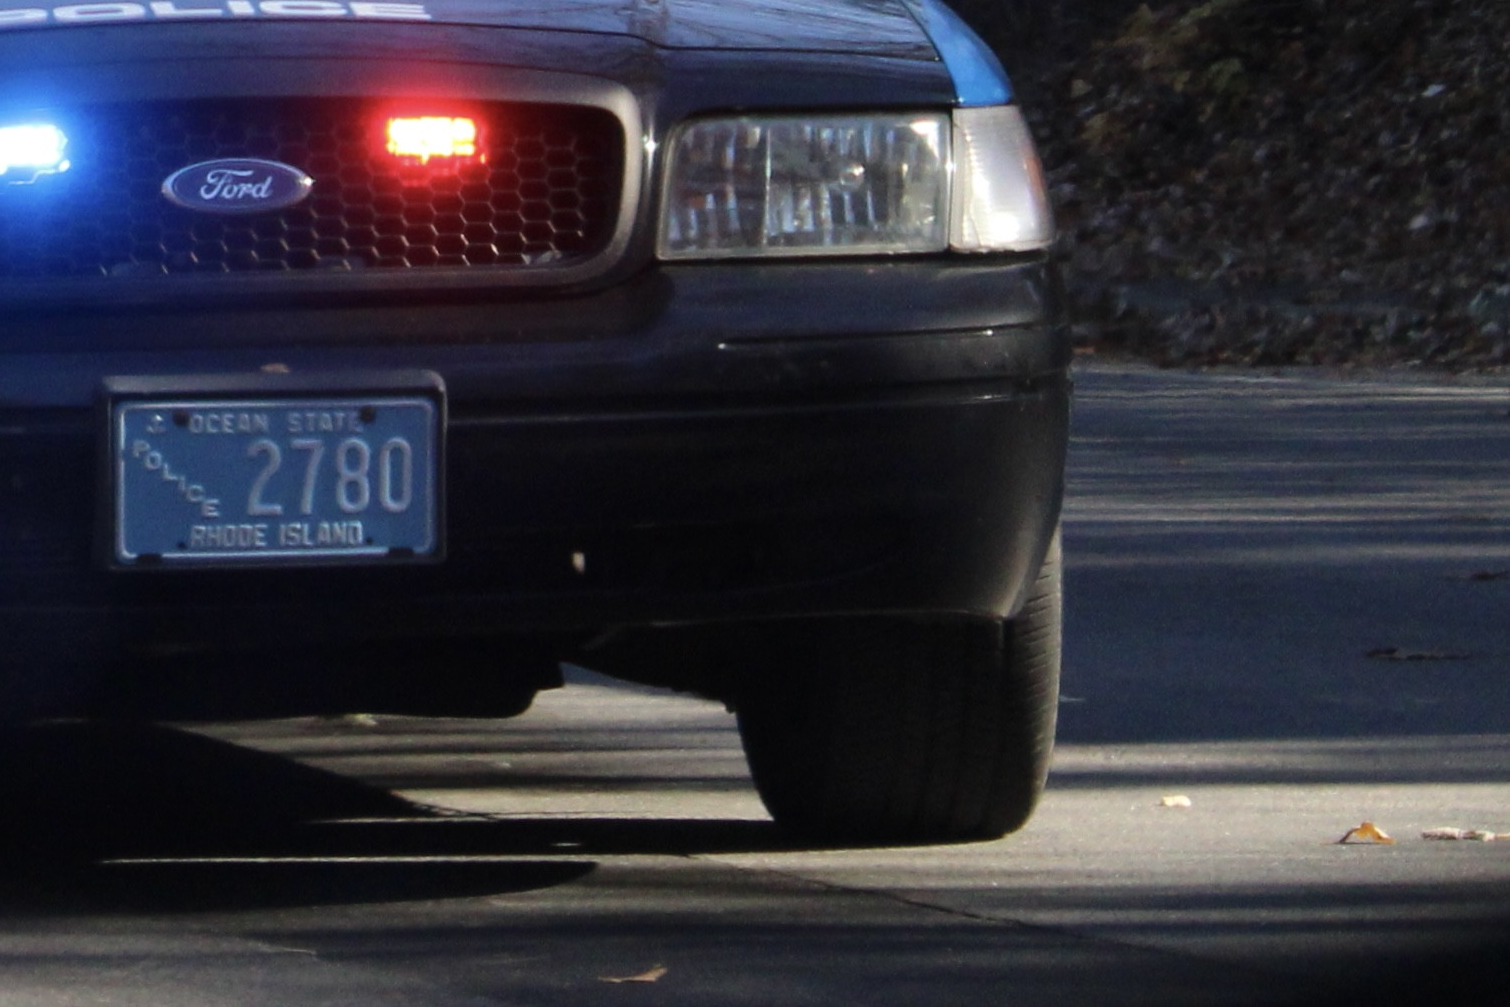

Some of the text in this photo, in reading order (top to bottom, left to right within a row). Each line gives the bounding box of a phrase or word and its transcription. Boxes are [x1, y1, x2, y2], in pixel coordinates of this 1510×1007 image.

[200, 169, 272, 200] Ford
[190, 411, 364, 433] OCEAN STATE
[132, 439, 220, 517] POLICE
[247, 437, 412, 515] 2780
[190, 520, 363, 546] RHODE ISLAND
